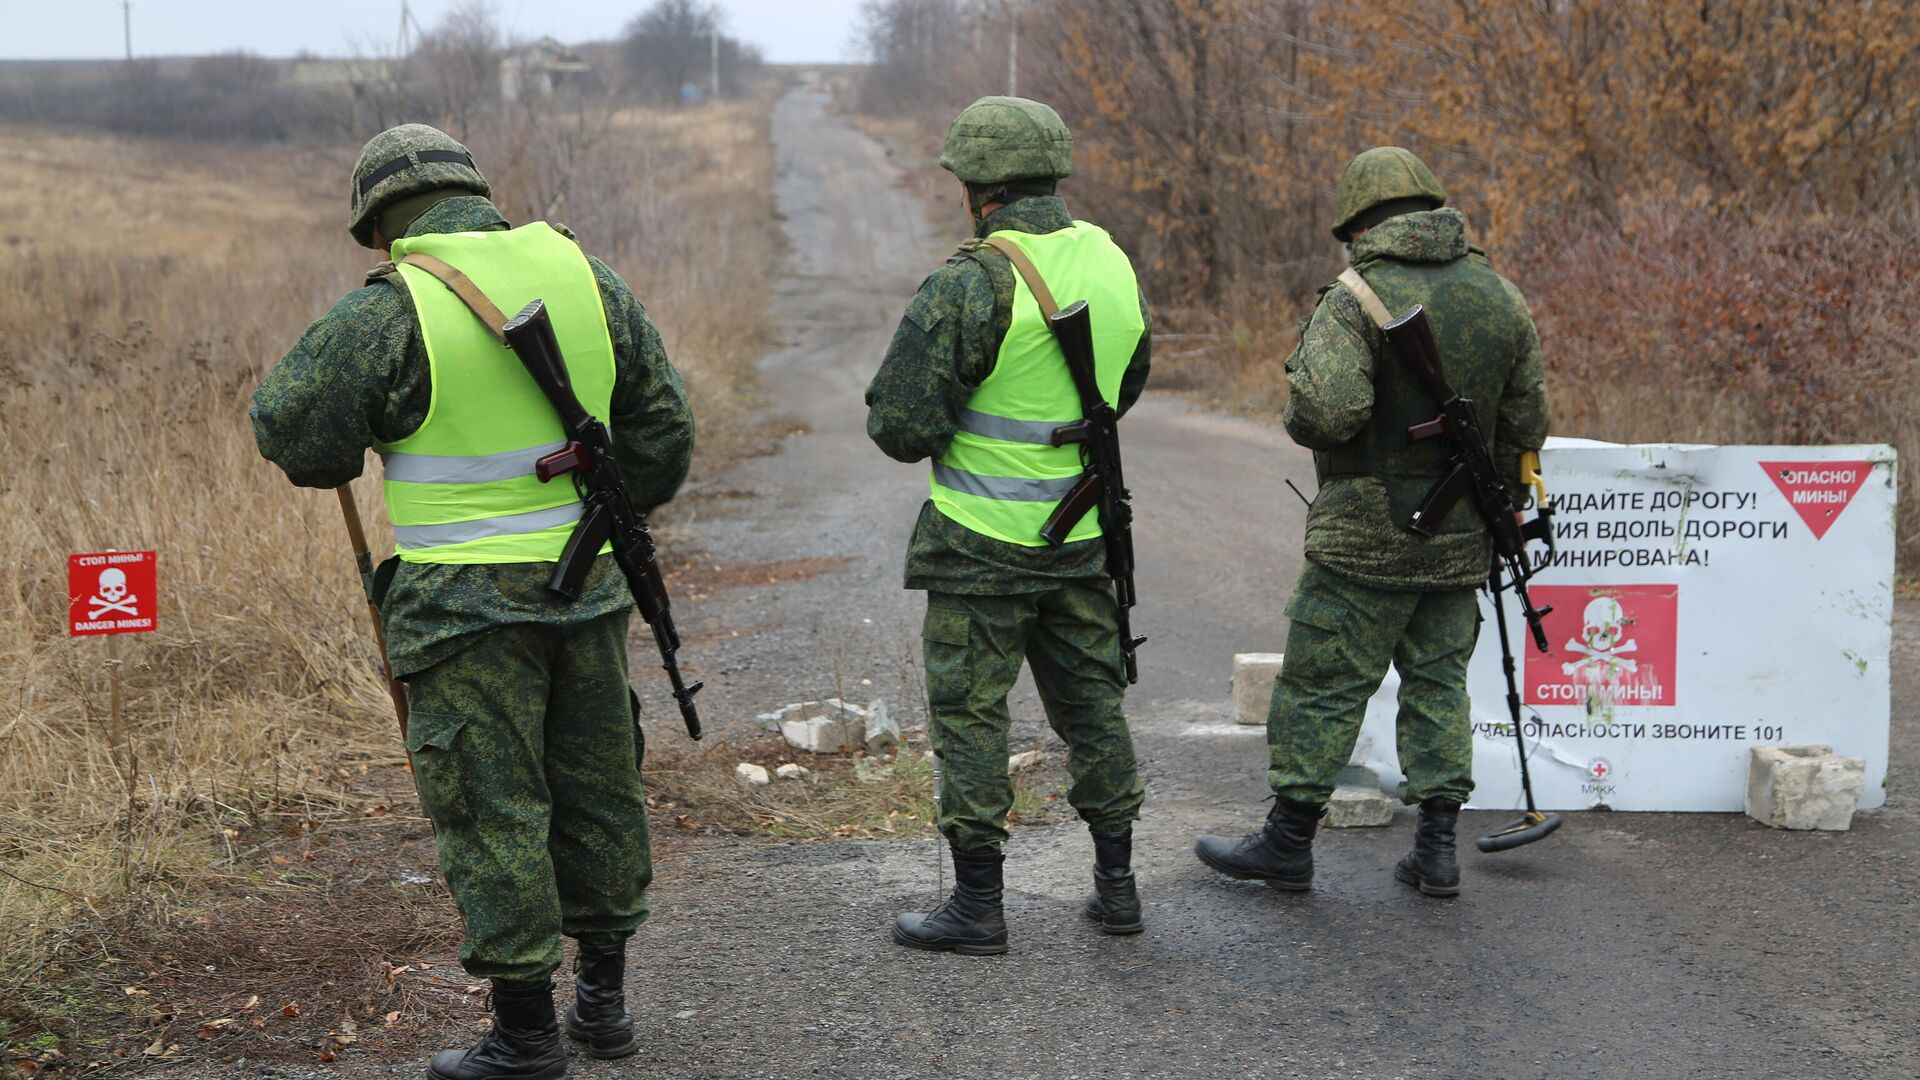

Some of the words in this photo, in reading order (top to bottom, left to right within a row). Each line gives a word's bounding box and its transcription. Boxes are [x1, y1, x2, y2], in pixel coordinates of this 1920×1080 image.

[1784, 470, 1857, 485] ОПАСНО!
[1650, 490, 1757, 513] ДОРОГУ!
[1793, 489, 1848, 504] МИНЫ!
[1551, 521, 1588, 539] ИЯ
[1597, 520, 1675, 542] ВДОЛЬ
[1684, 520, 1788, 541] ДОРОГИ
[79, 556, 106, 566] СТОП
[75, 620, 115, 631] DANGER
[117, 618, 151, 628] MINES!
[1600, 684, 1662, 699] МИНЫ!
[1523, 723, 1646, 738] ОПАСНОСТИ
[1652, 724, 1746, 740] ЗВОНИТЕ
[1753, 726, 1784, 741] 101
